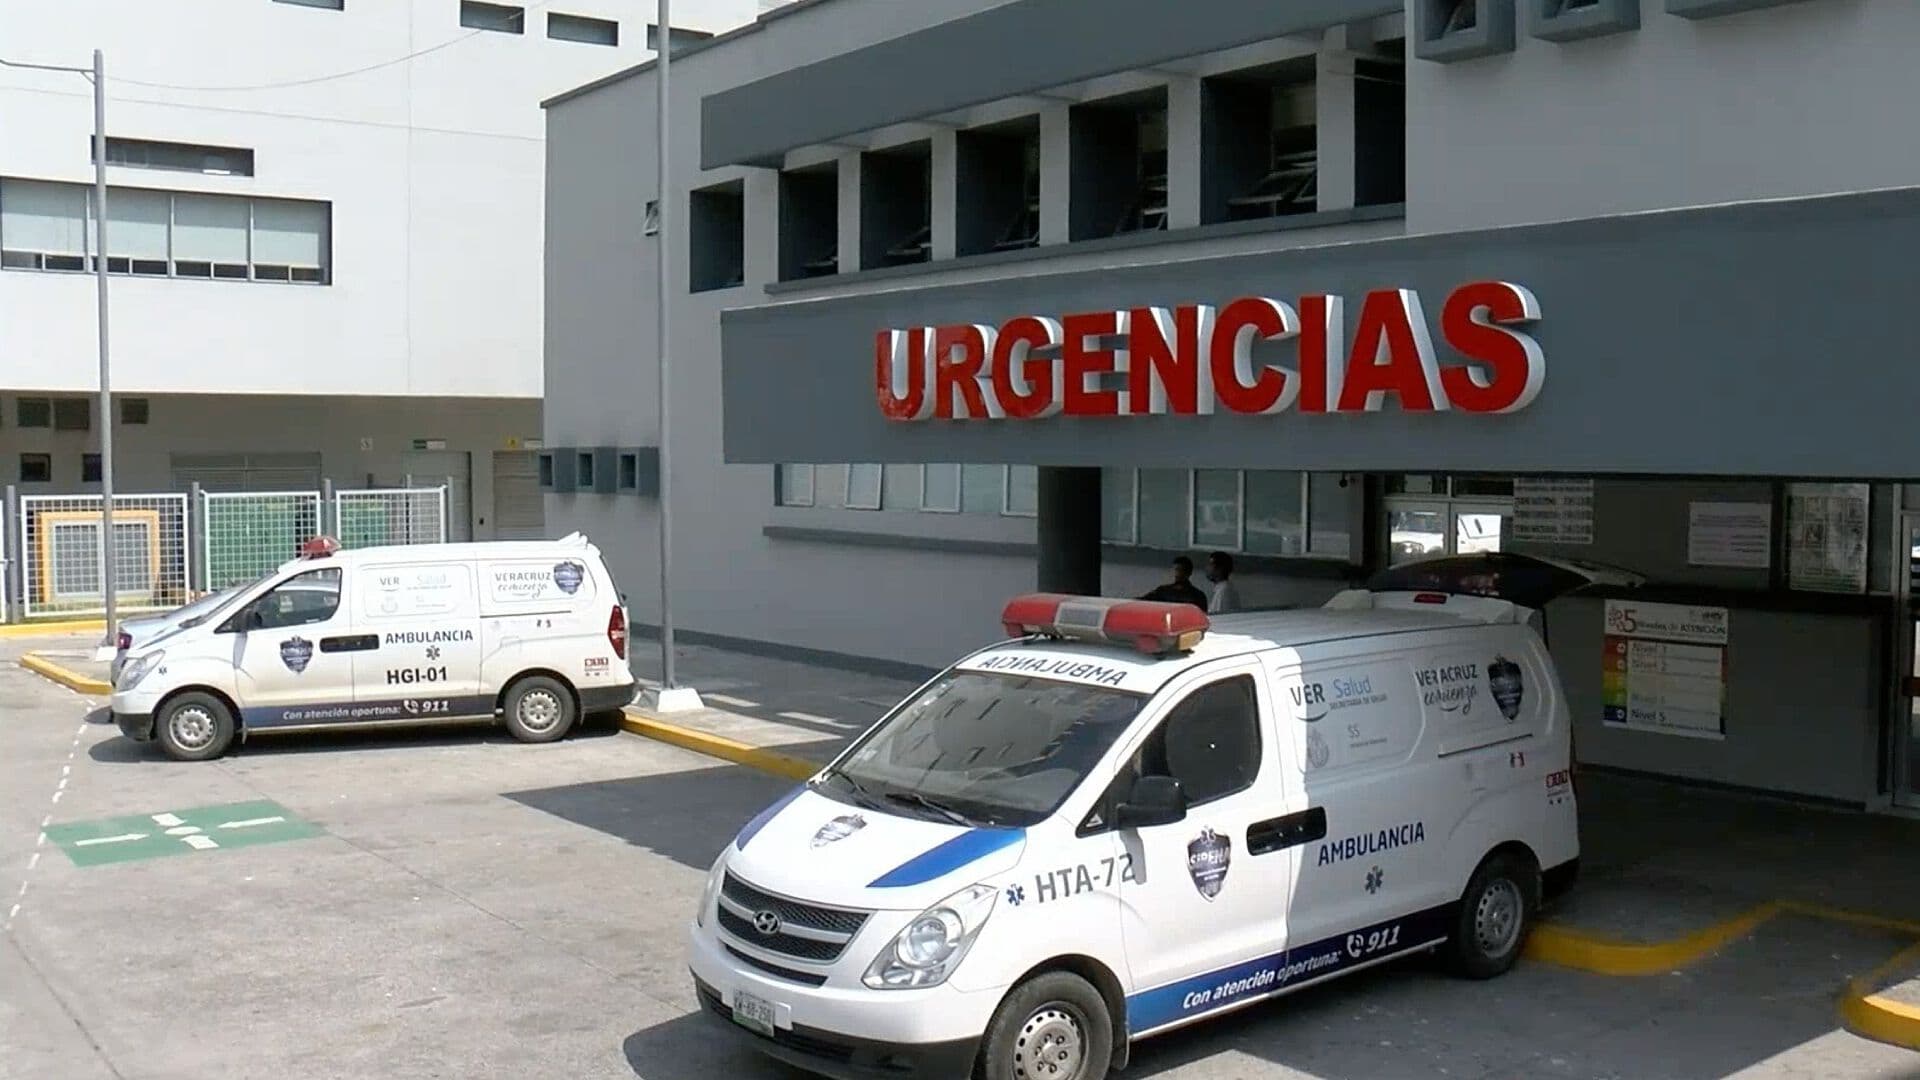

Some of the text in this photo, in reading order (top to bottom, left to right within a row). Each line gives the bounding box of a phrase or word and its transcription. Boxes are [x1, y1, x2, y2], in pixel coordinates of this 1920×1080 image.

[875, 281, 1545, 421] URGENCIAS
[379, 576, 400, 586] VER
[495, 571, 551, 582] VERACRUZ
[385, 629, 473, 645] AMBULANCIA
[387, 666, 448, 685] HGI-01
[1333, 675, 1372, 699] Salud
[1415, 664, 1478, 687] VERACRUZ
[1290, 682, 1326, 706] VER
[283, 705, 401, 720] Con atención oportuna:
[423, 700, 449, 712] 911
[1318, 821, 1425, 867] AMBULANCIA
[1035, 852, 1137, 904] HTA-72
[1366, 926, 1400, 953] 911
[1183, 949, 1343, 1009] Con atención oportuna:
